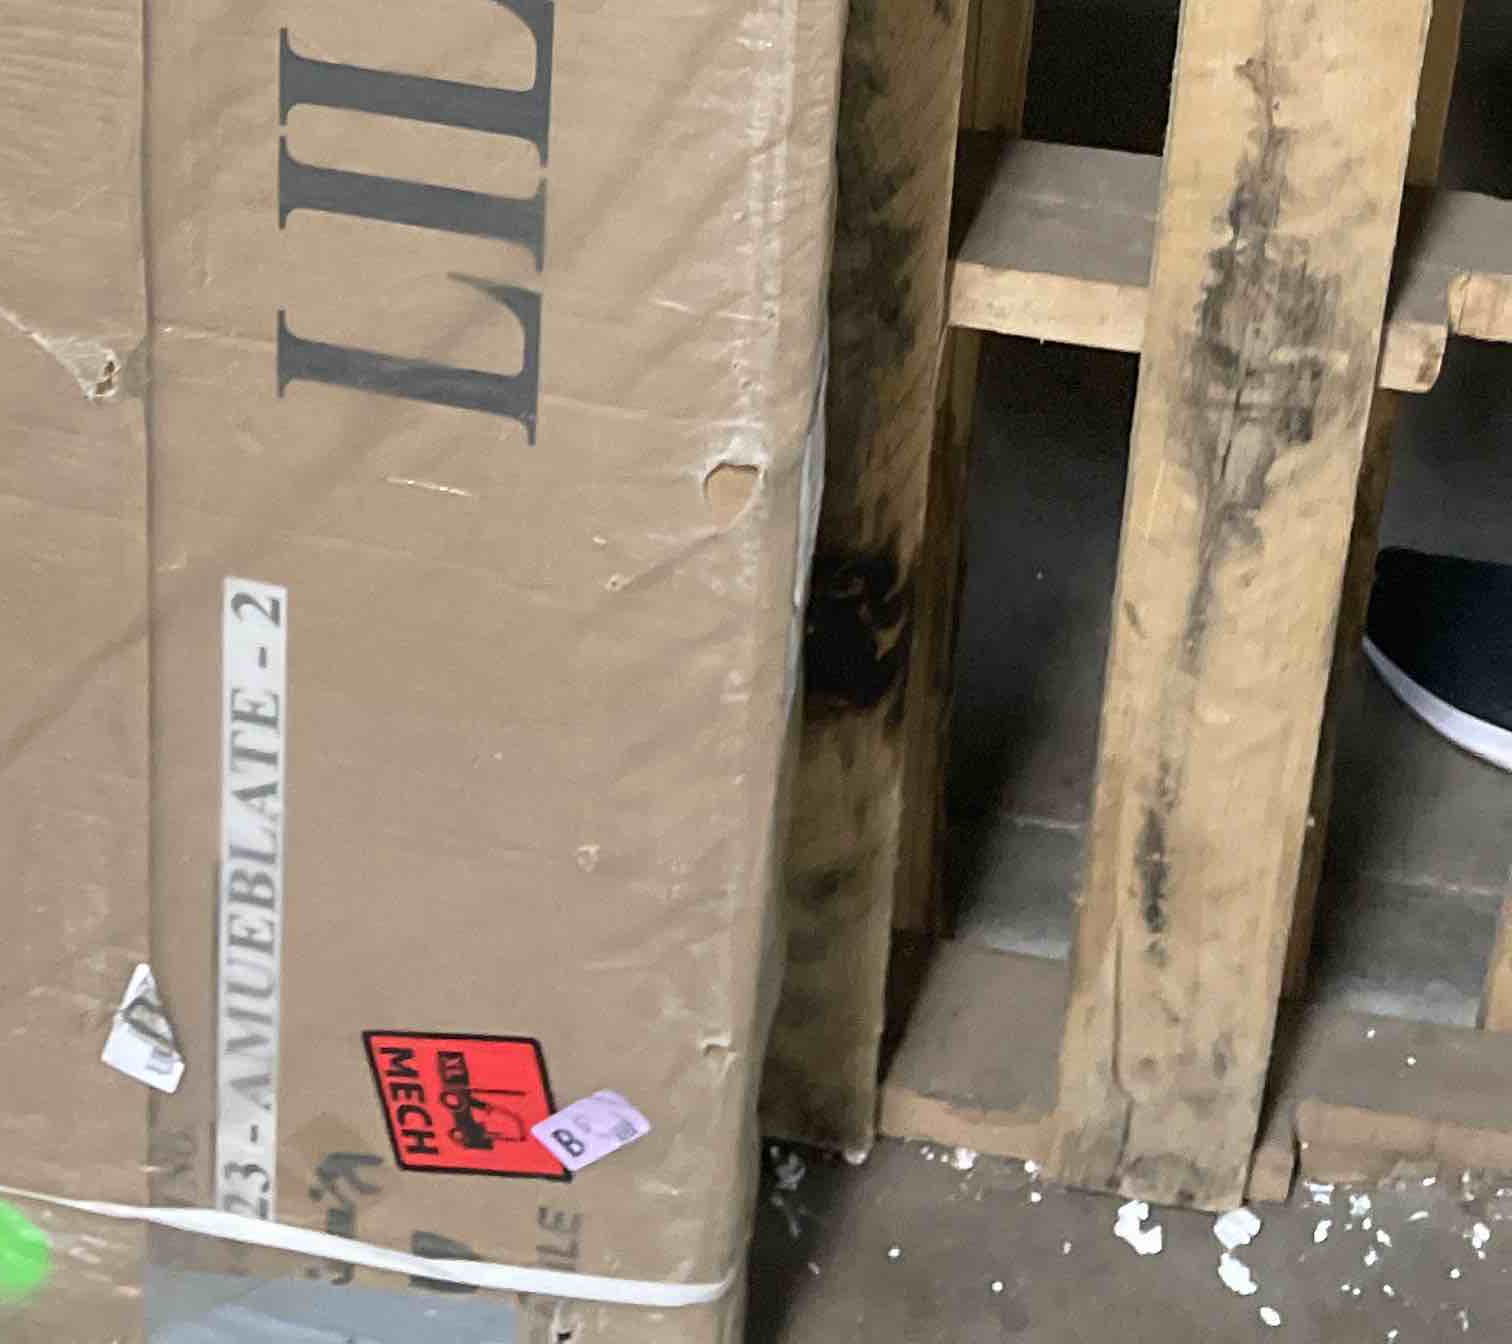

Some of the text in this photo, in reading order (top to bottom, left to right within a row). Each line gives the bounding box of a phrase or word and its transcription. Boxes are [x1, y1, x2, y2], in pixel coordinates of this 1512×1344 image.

[230, 590, 282, 629] 2
[224, 686, 282, 1113] AMUEBLATE
[378, 1046, 439, 1156] MECH
[551, 1128, 586, 1159] B
